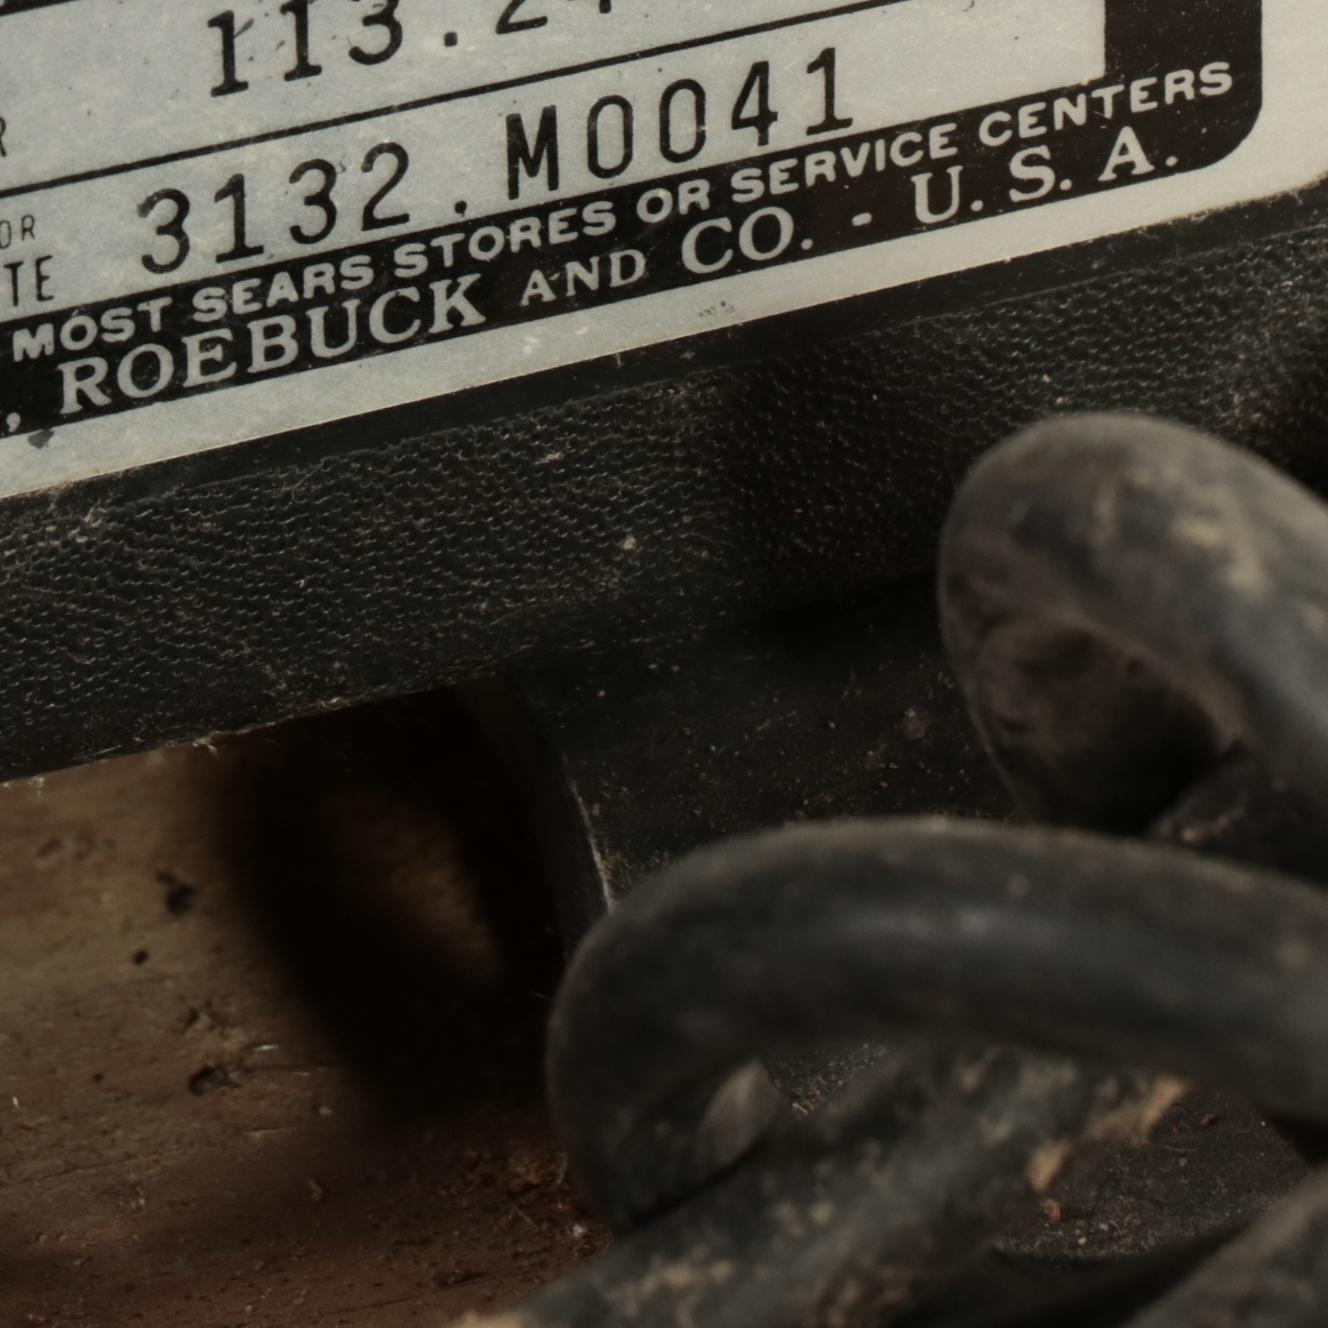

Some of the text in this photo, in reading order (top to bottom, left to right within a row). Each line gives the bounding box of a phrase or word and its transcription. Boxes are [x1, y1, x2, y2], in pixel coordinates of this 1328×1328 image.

[13, 299, 171, 360] MOST
[195, 255, 373, 321] SEARS
[394, 202, 615, 278] STORES
[638, 178, 710, 222] OR
[730, 130, 956, 202] SERVICE
[980, 62, 1233, 147] CENTERS
[59, 274, 486, 415] ROEBUCK
[519, 252, 644, 307] AND
[682, 208, 813, 274] CO.
